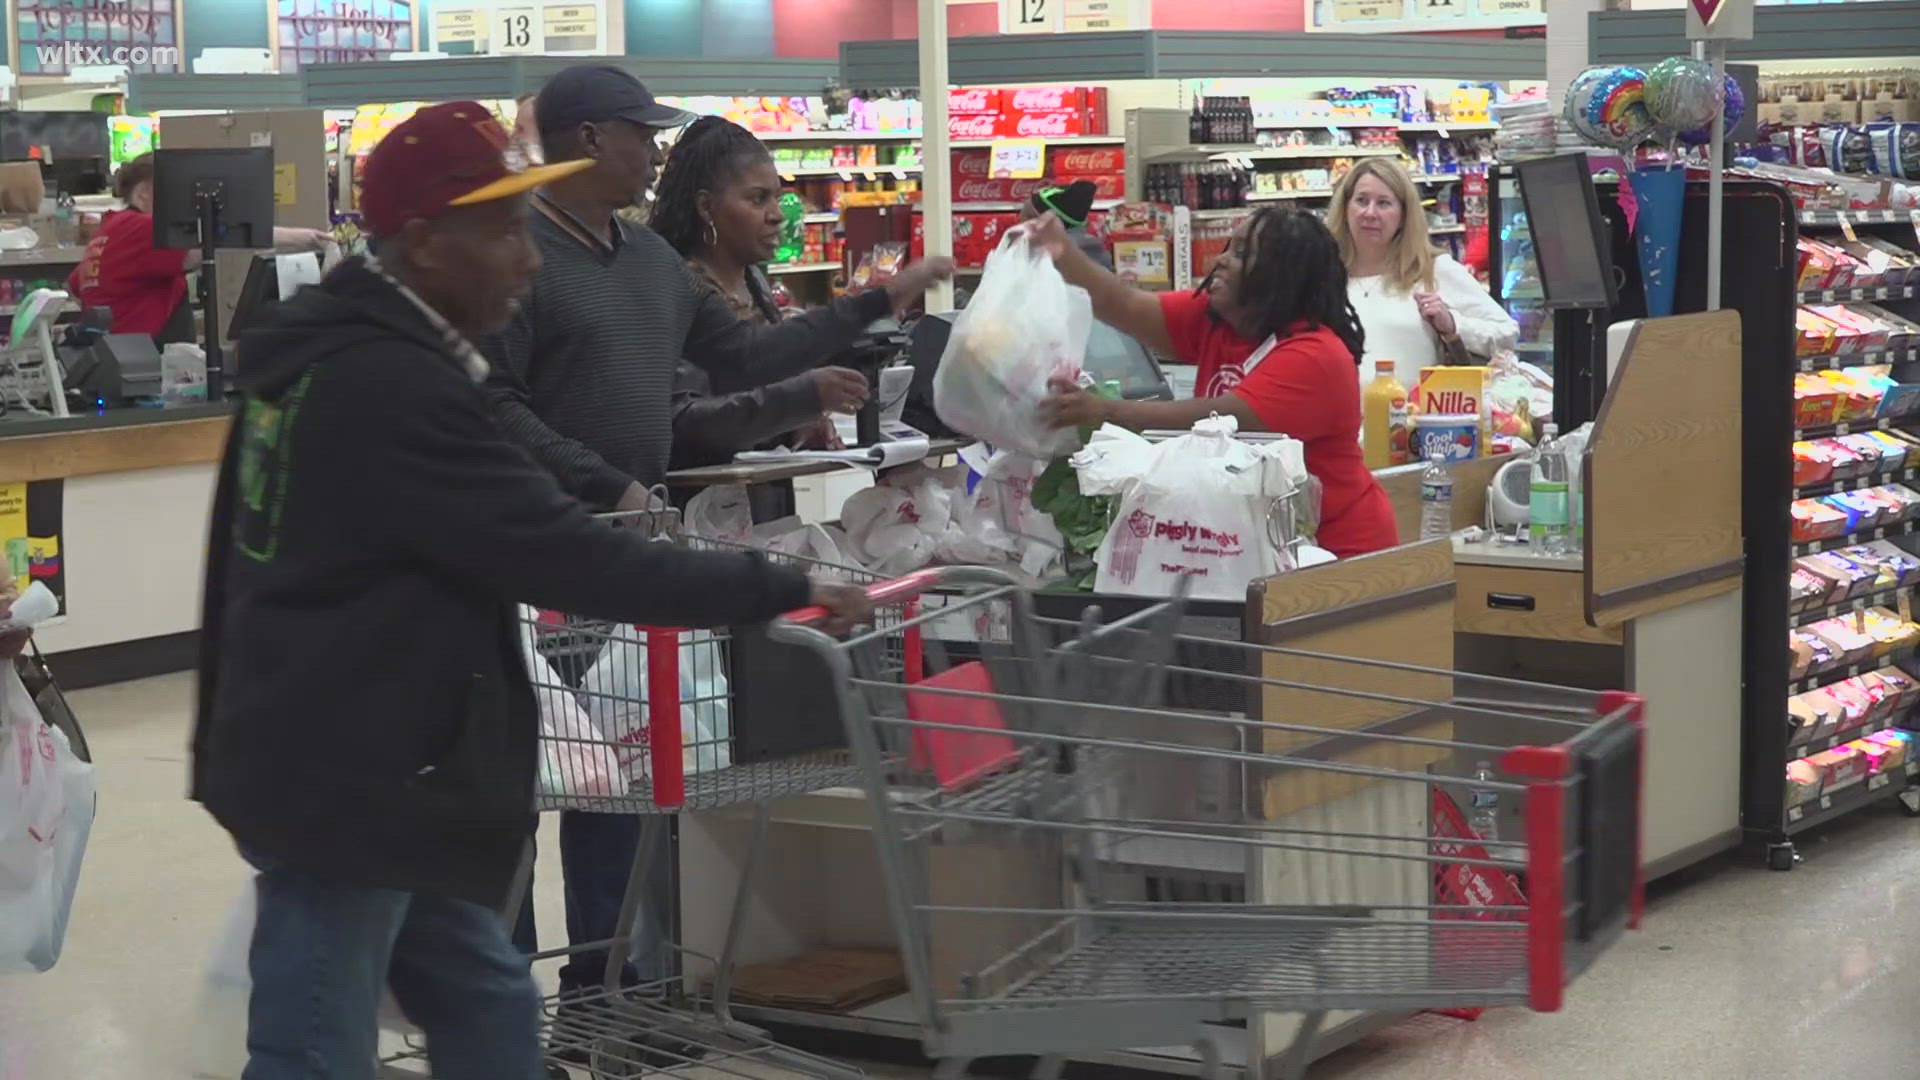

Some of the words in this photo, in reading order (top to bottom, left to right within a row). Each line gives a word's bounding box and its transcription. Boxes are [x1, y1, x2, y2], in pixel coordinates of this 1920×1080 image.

[1019, 0, 1045, 23] 12
[1498, 0, 1530, 9] DRINKS
[503, 15, 531, 47] 13
[1426, 391, 1477, 414] Nilla
[1424, 430, 1454, 446] Cool
[1423, 441, 1458, 458] Whip
